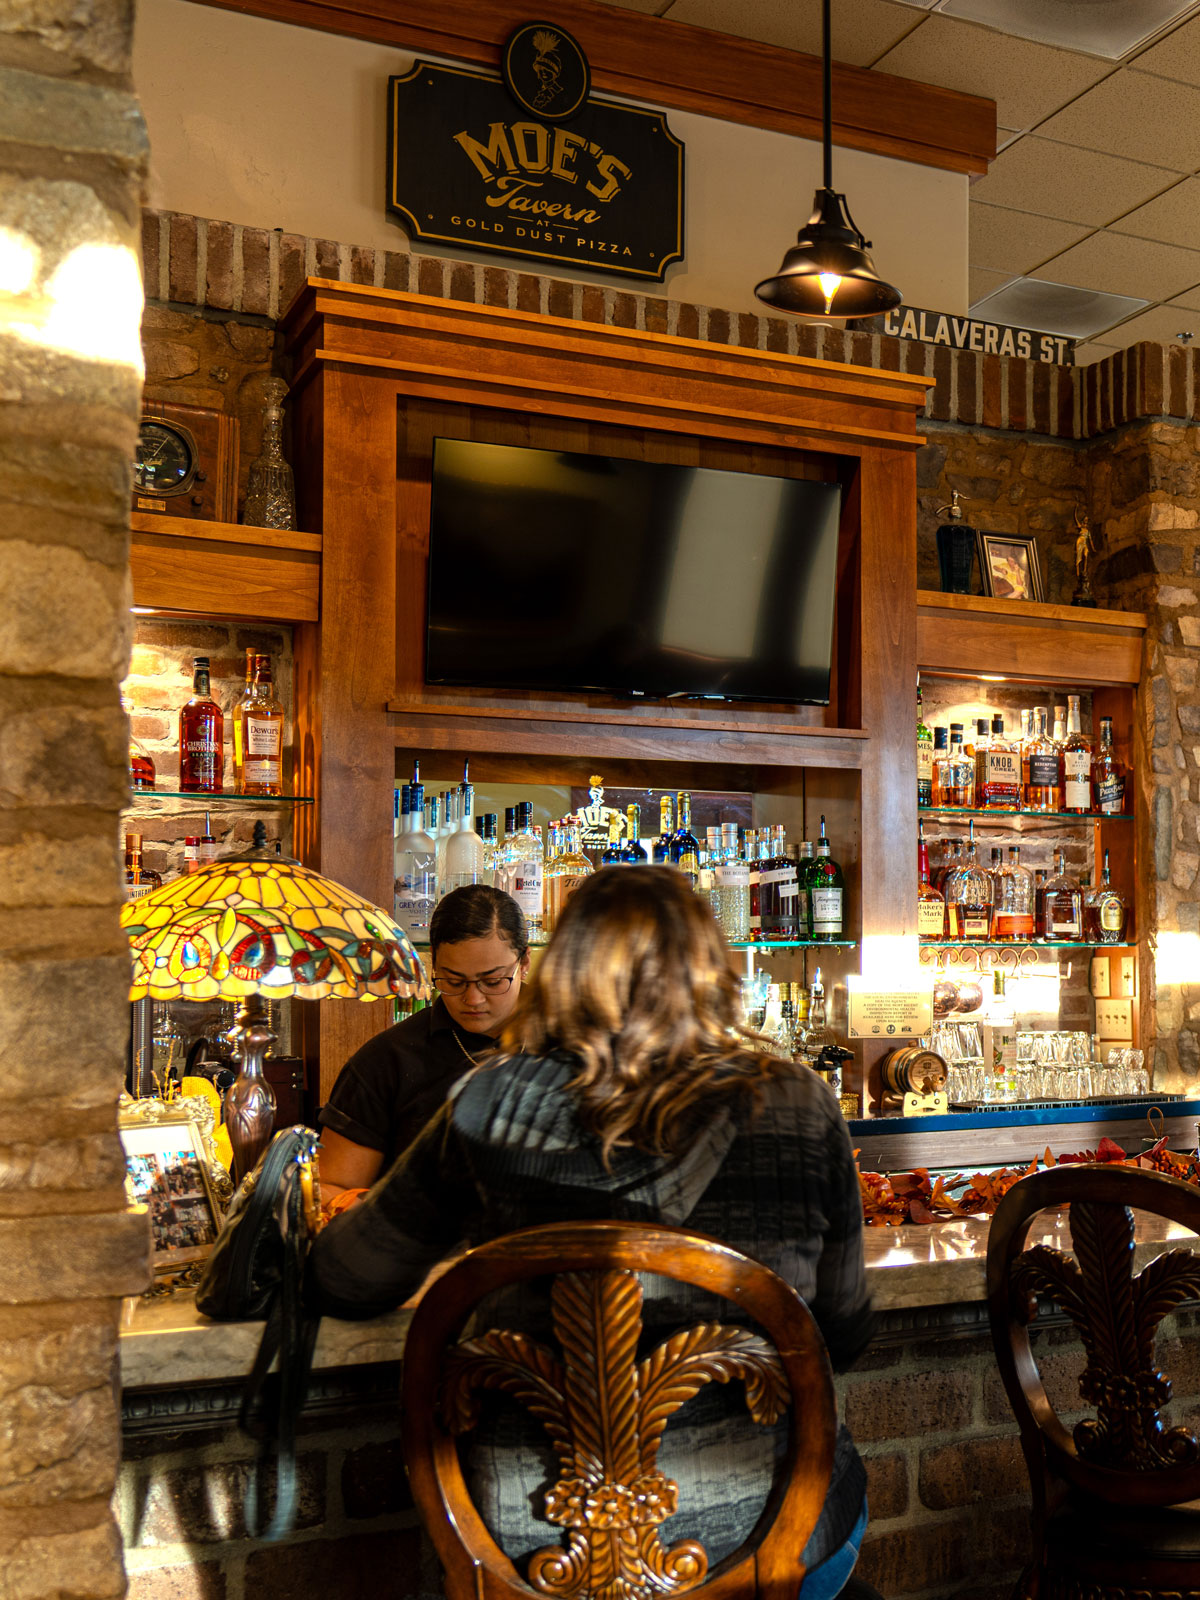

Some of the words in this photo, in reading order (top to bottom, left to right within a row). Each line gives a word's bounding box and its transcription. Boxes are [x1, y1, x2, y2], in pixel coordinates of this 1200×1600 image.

[452, 121, 633, 203] MOE'S
[485, 175, 601, 224] Tavern
[451, 215, 505, 233] GOLD
[516, 227, 567, 244] DUST
[577, 237, 633, 256] PIZZA
[536, 219, 550, 228] AT
[884, 307, 1031, 360] CALAVERAS
[1040, 335, 1072, 367] ST.
[250, 725, 279, 735] Dewar's
[990, 756, 1012, 767] KNOB
